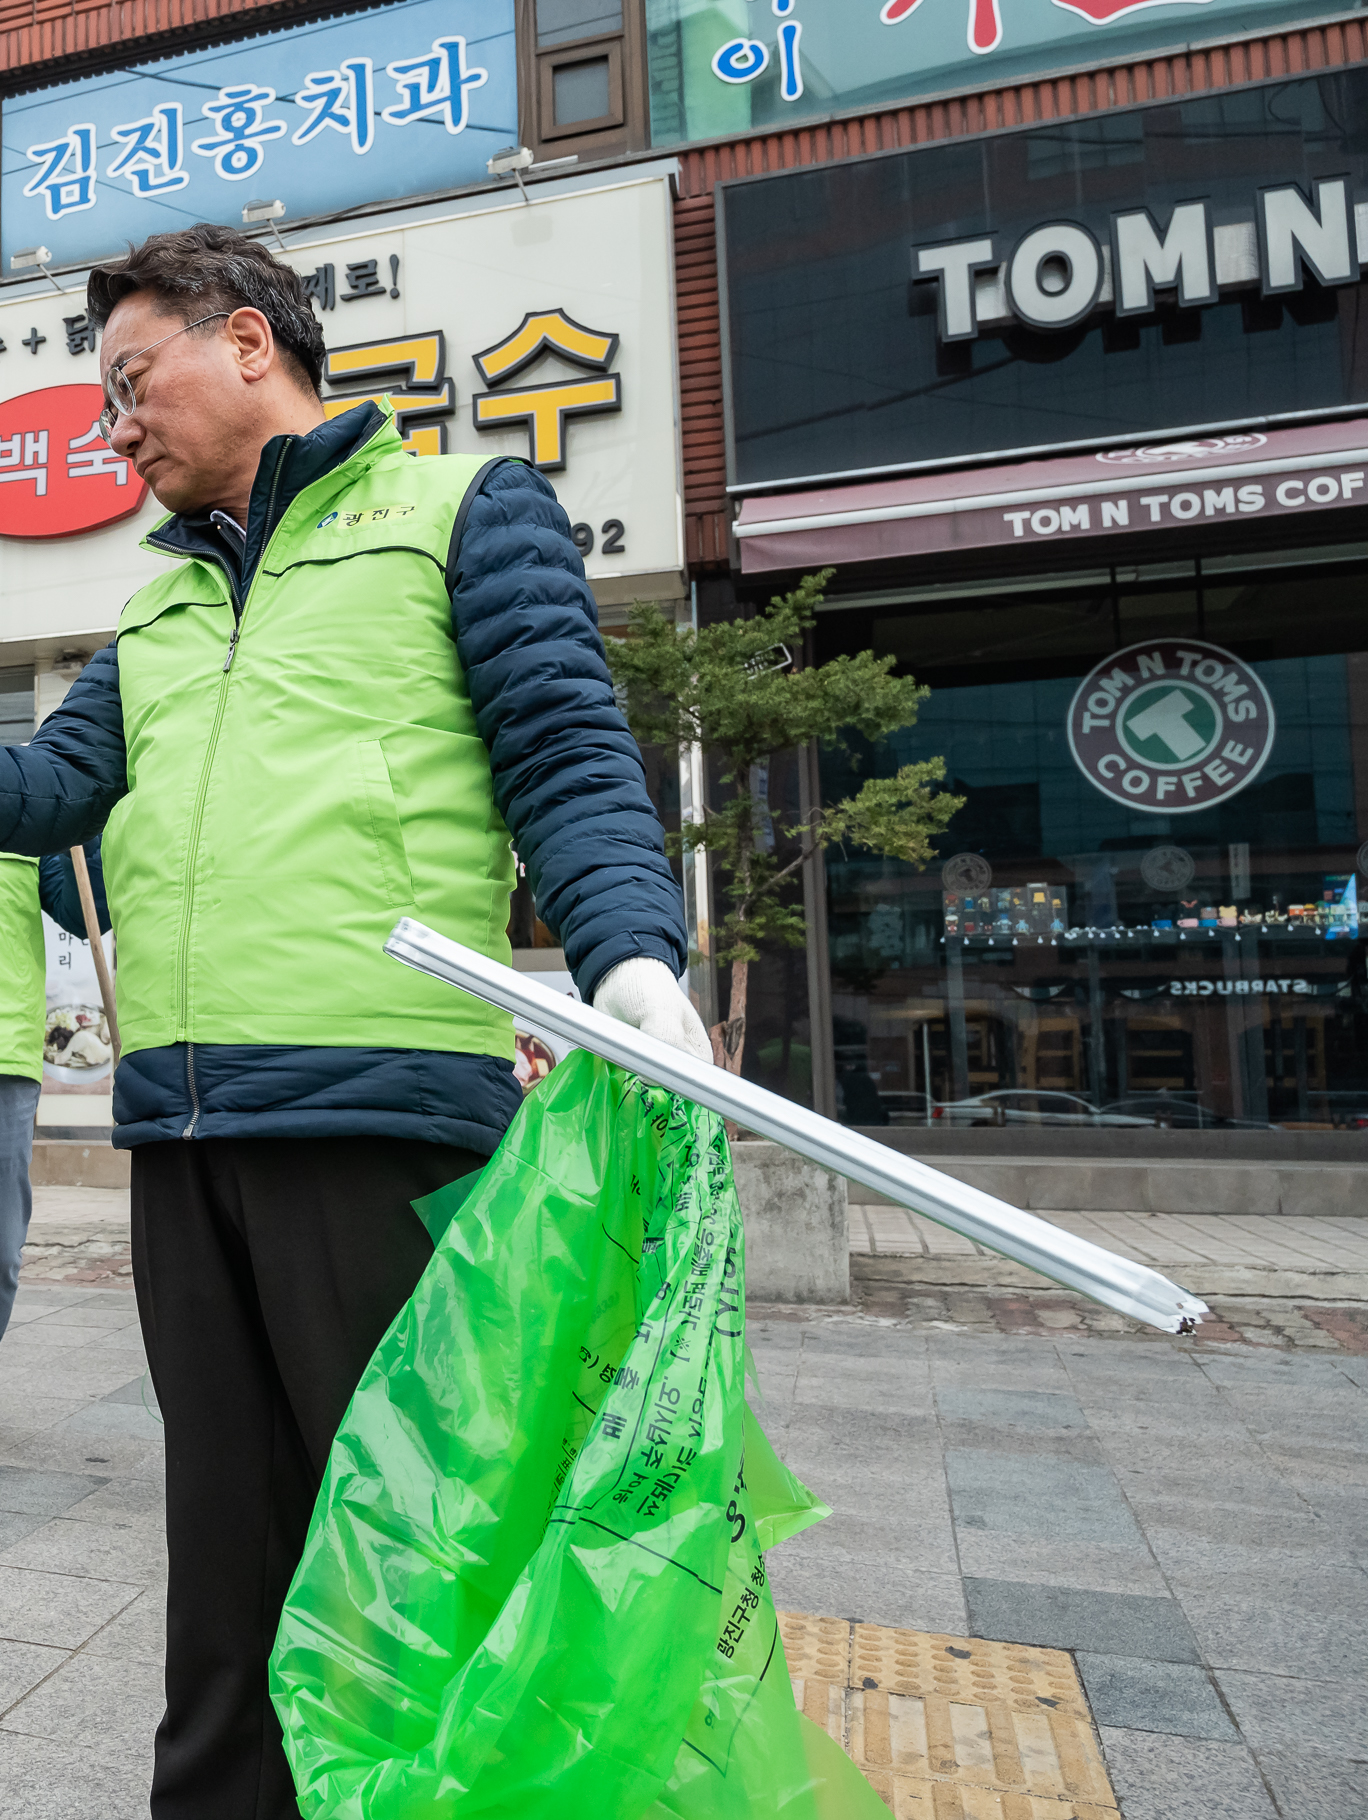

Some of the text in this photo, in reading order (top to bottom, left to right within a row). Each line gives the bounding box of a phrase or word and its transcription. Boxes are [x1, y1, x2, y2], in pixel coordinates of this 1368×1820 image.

[24, 35, 488, 220] 김진홍치과
[914, 175, 1359, 342] TOM N
[1004, 503, 1091, 538] TOM
[1101, 500, 1130, 528] N
[1140, 484, 1266, 522] TOMS
[1081, 648, 1259, 734] TOM N TOMS
[1096, 738, 1255, 800] COFFEE
